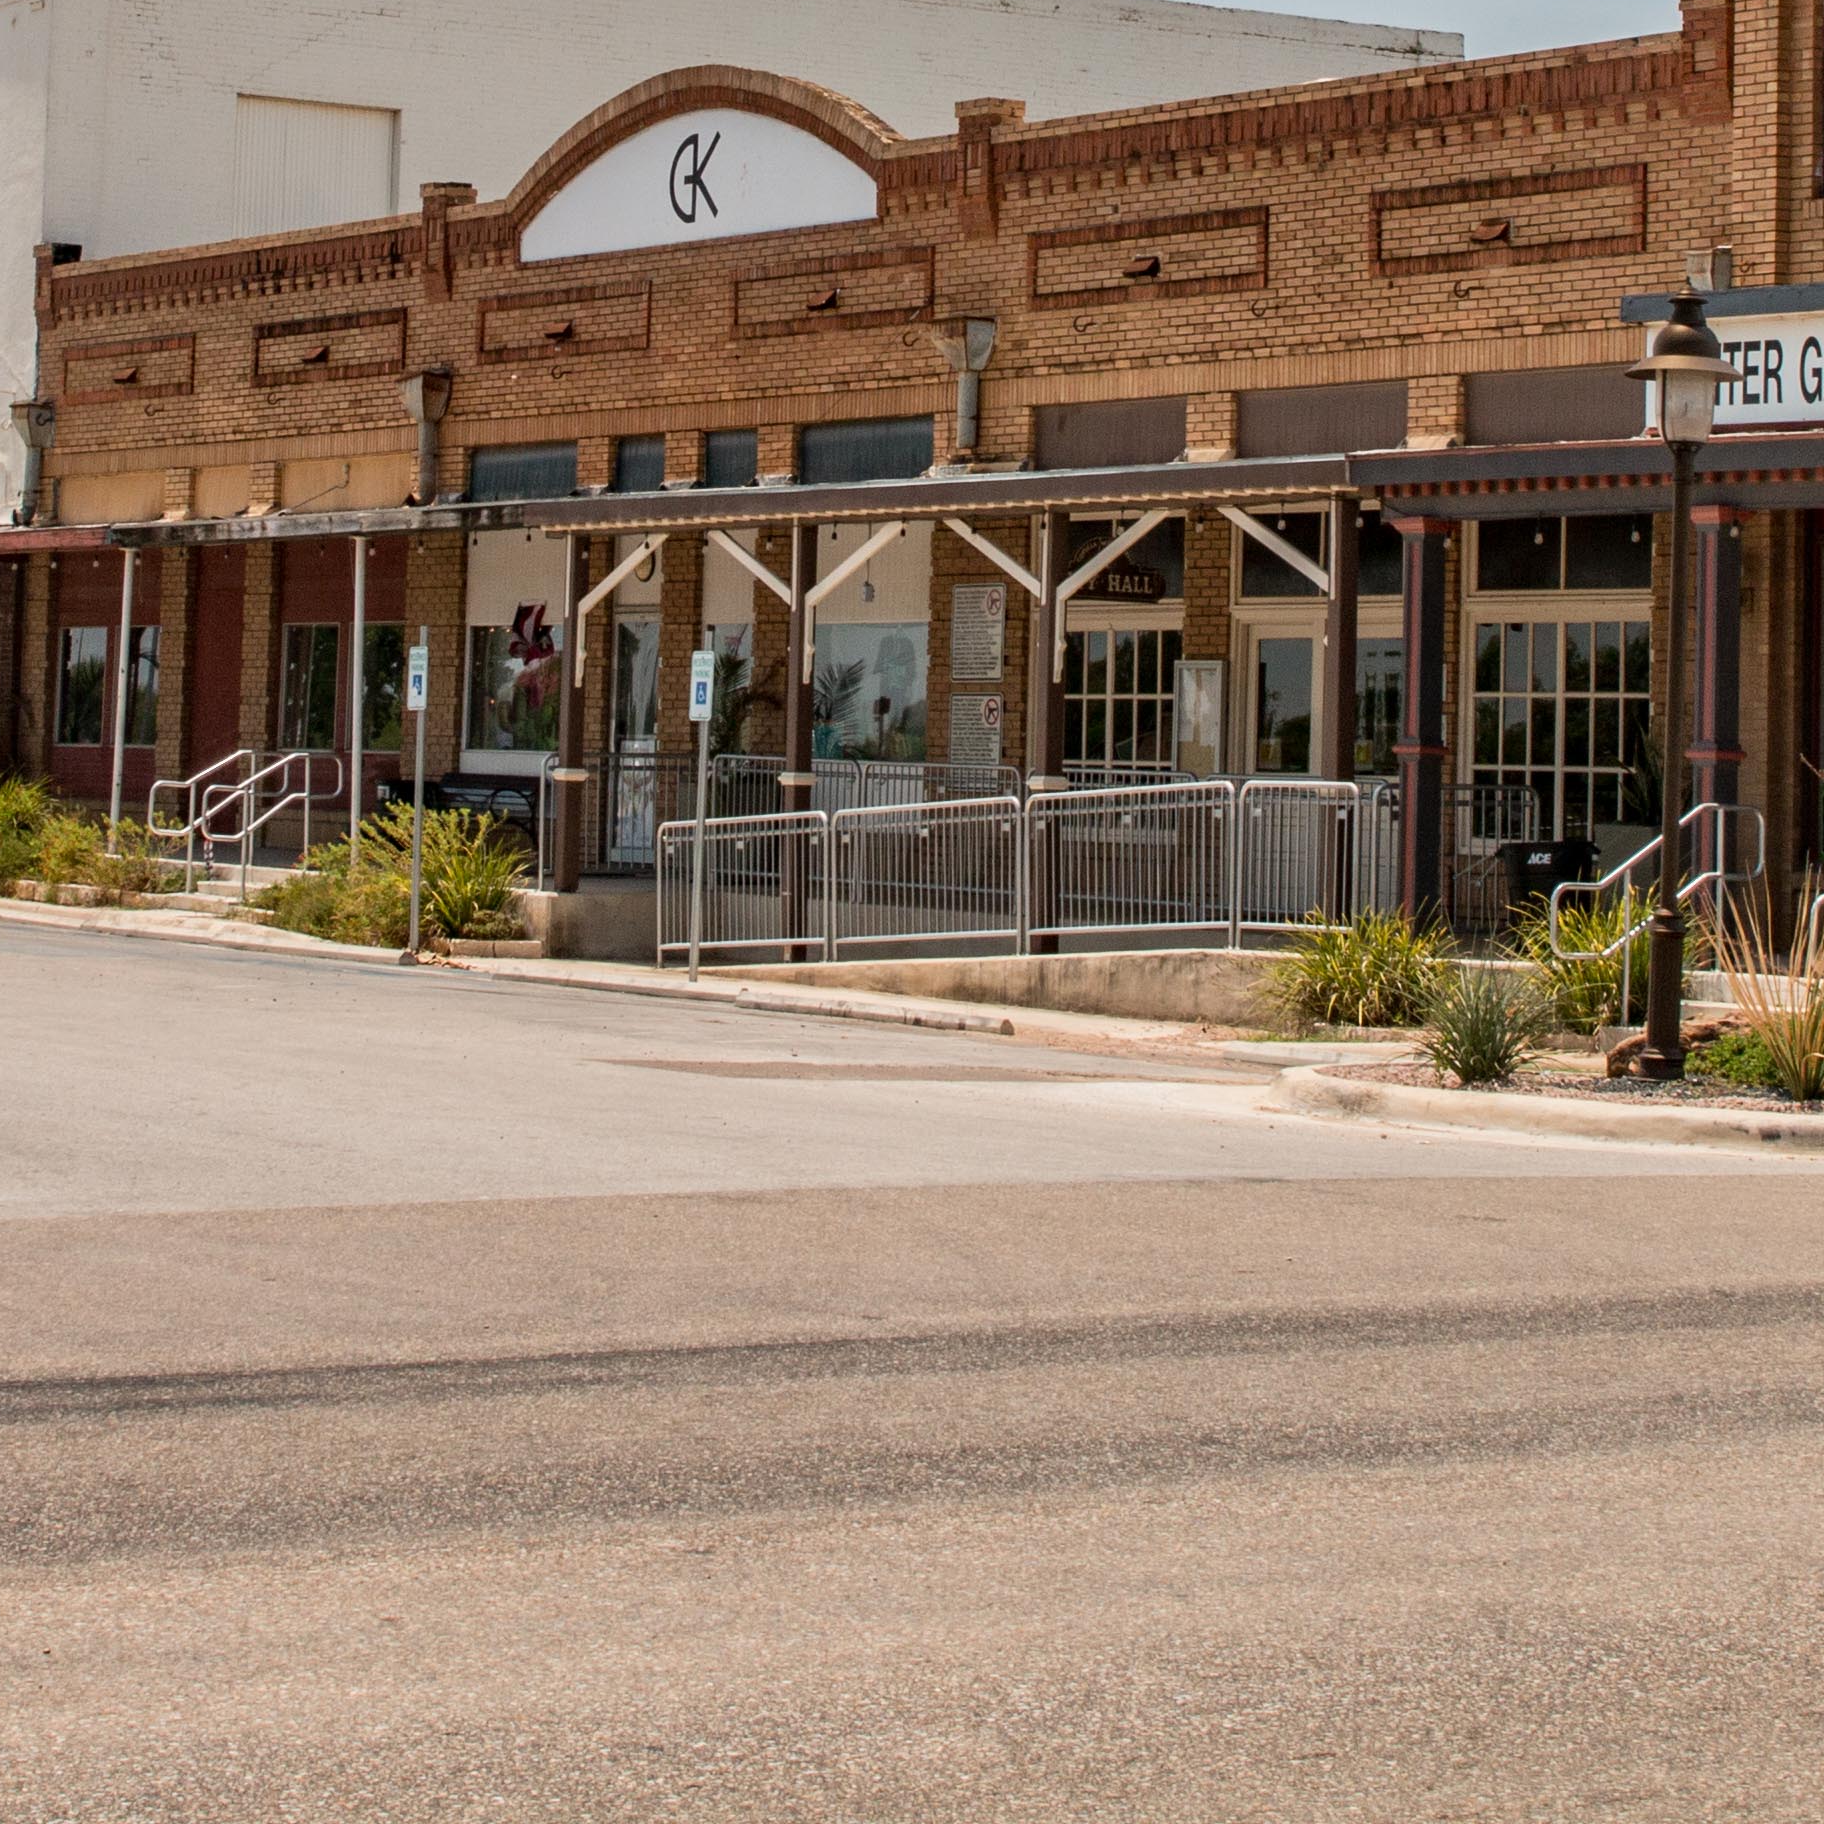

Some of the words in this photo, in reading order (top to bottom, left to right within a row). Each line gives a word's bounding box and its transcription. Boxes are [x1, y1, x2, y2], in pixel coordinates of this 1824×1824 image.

[1714, 339, 1784, 406] TER
[1108, 574, 1153, 594] HALL
[1527, 852, 1552, 864] ACE
